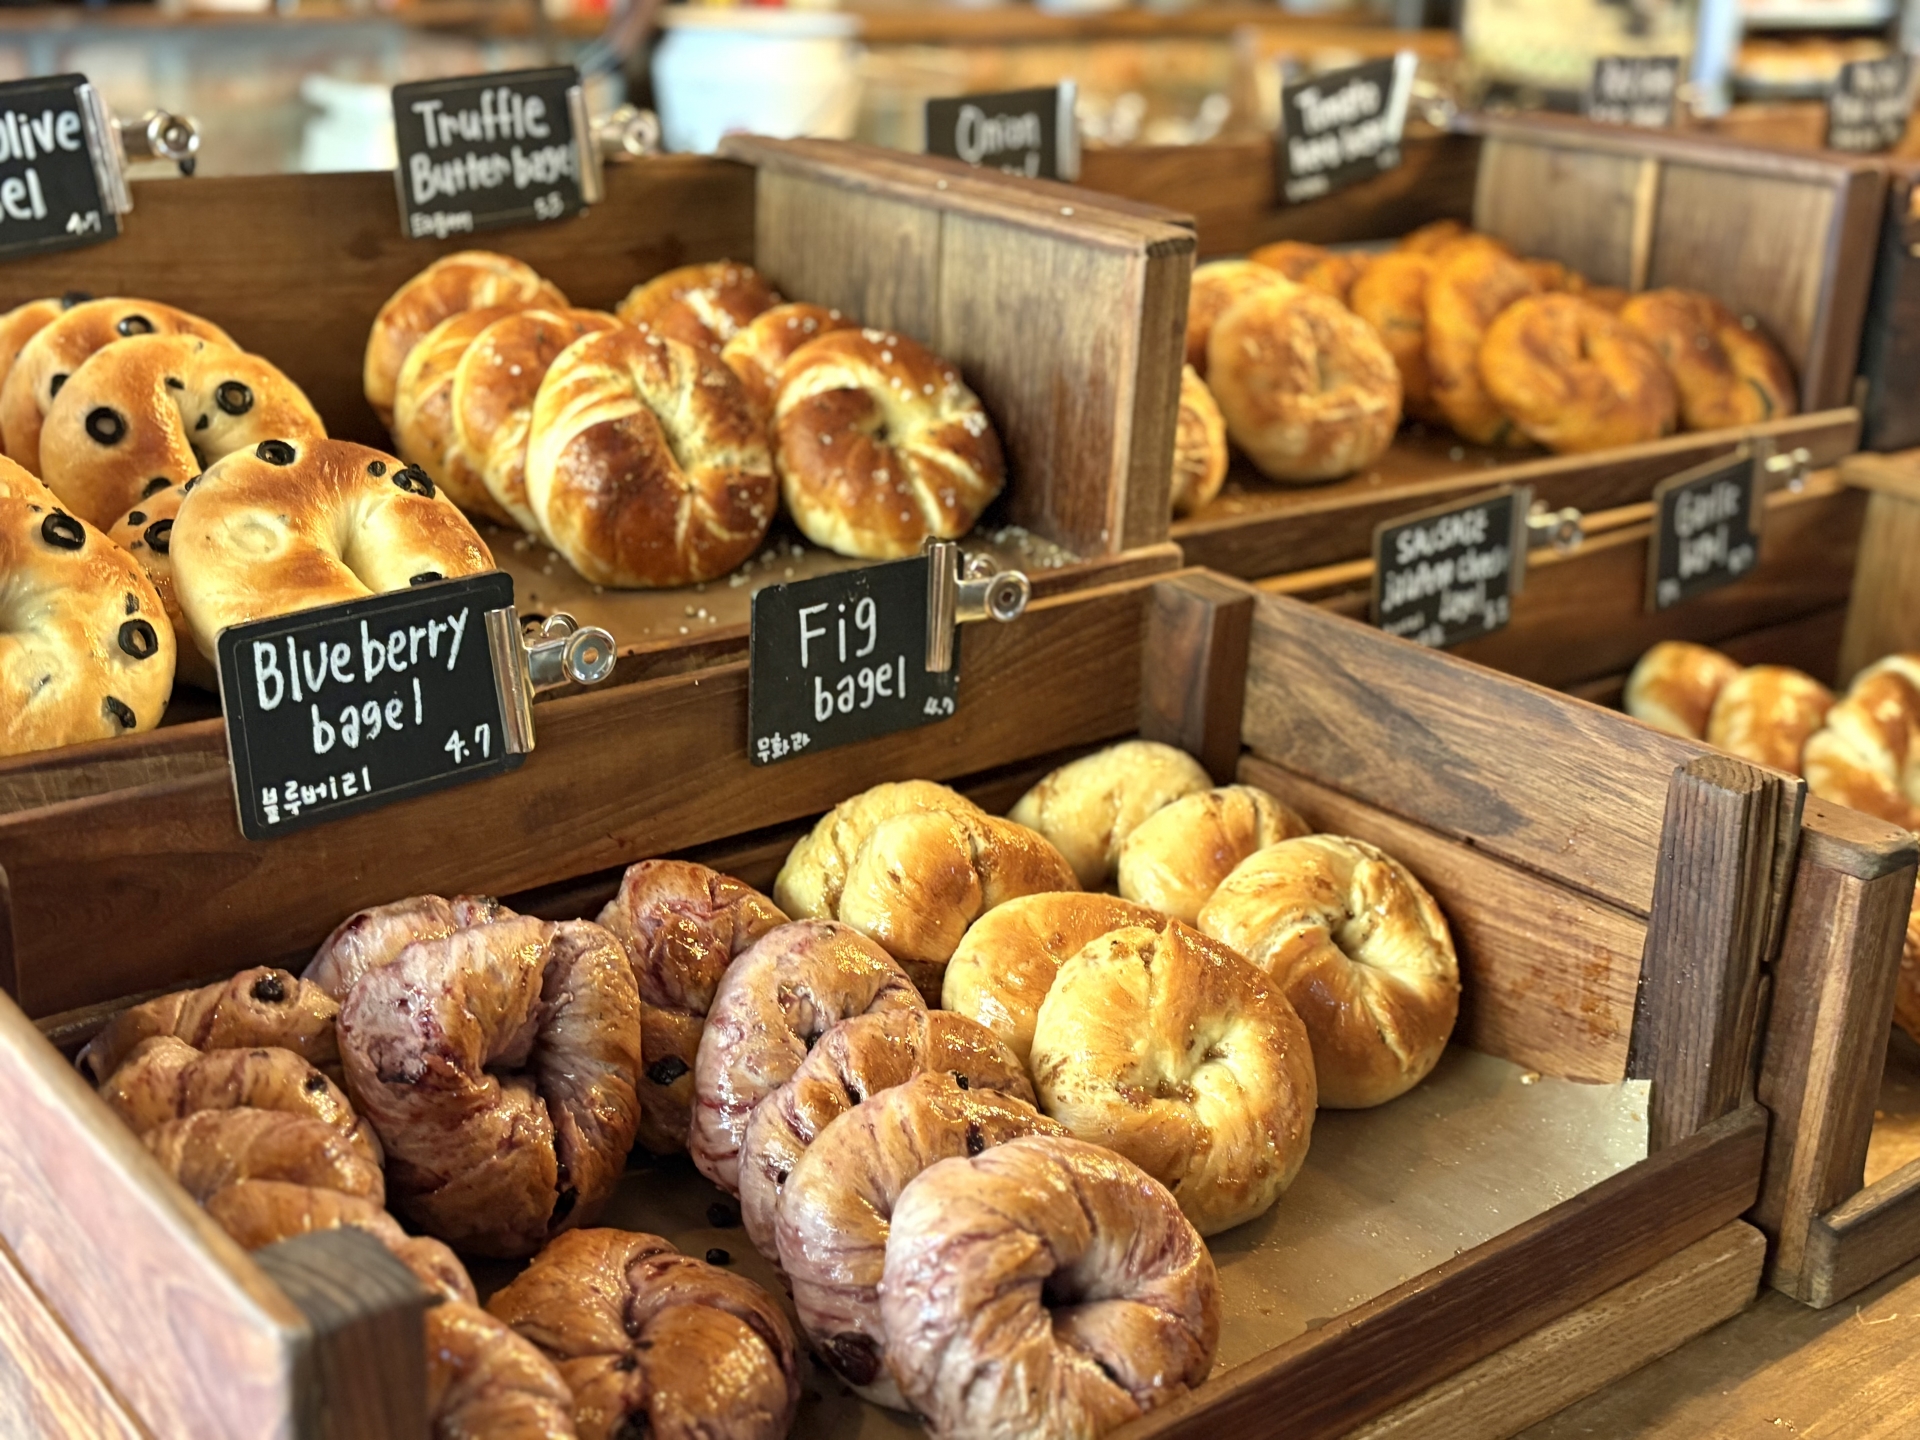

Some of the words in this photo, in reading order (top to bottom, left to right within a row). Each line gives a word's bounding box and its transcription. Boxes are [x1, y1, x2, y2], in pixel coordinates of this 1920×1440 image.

[411, 86, 551, 148] Truffle
[410, 152, 511, 206] Butter
[253, 607, 469, 711] Blueberry
[799, 597, 877, 669] Fig
[311, 677, 423, 755] bagel
[814, 655, 906, 723] bagel
[444, 723, 491, 764] 4.7
[262, 765, 372, 825] 블루베리
